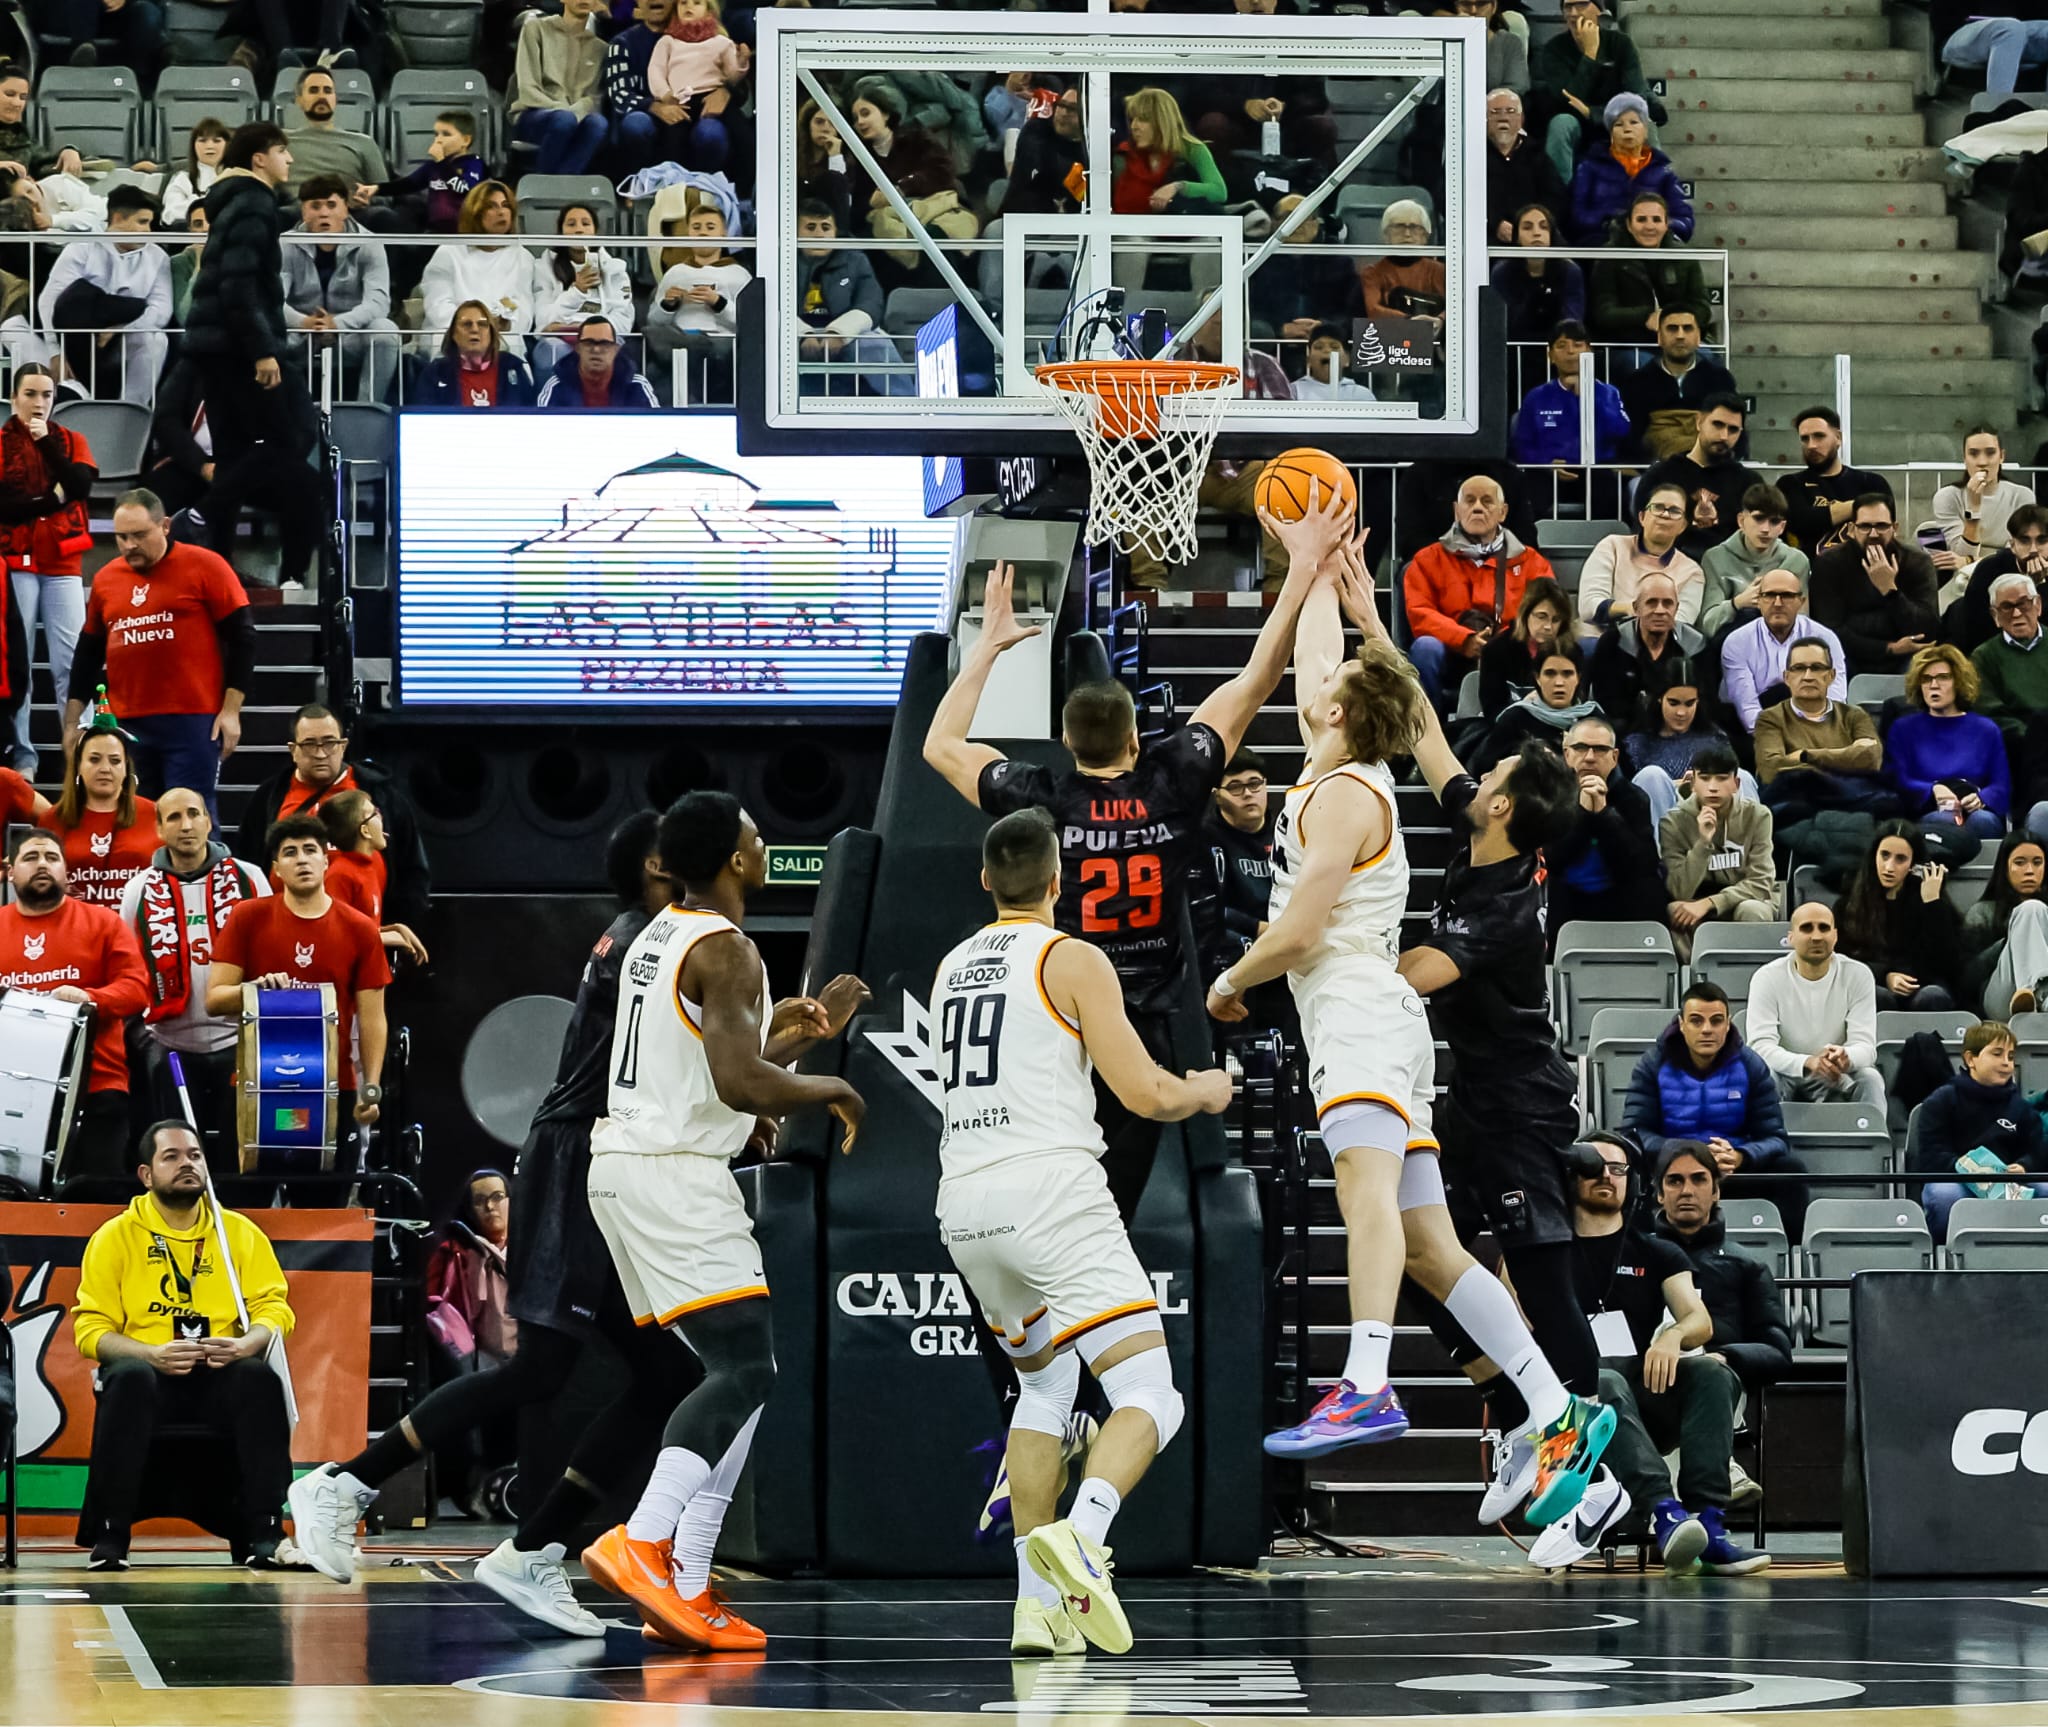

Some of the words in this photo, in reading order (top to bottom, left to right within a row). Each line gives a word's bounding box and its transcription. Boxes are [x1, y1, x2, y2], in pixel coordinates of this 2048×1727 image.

[1652, 81, 1662, 94] 4
[1682, 183, 1691, 196] 3
[1711, 289, 1720, 303] 2
[1388, 345, 1409, 357] liga
[1388, 356, 1432, 366] endesa
[1744, 399, 1751, 412] 1
[123, 628, 175, 645] Nueva
[1090, 799, 1149, 821] LUKA
[1062, 823, 1174, 851] PULEVA
[772, 857, 824, 872] SALID
[1080, 853, 1163, 932] 29
[942, 993, 1007, 1094] 99
[951, 1115, 1011, 1133] MURCIA
[836, 1273, 972, 1320] CAJA
